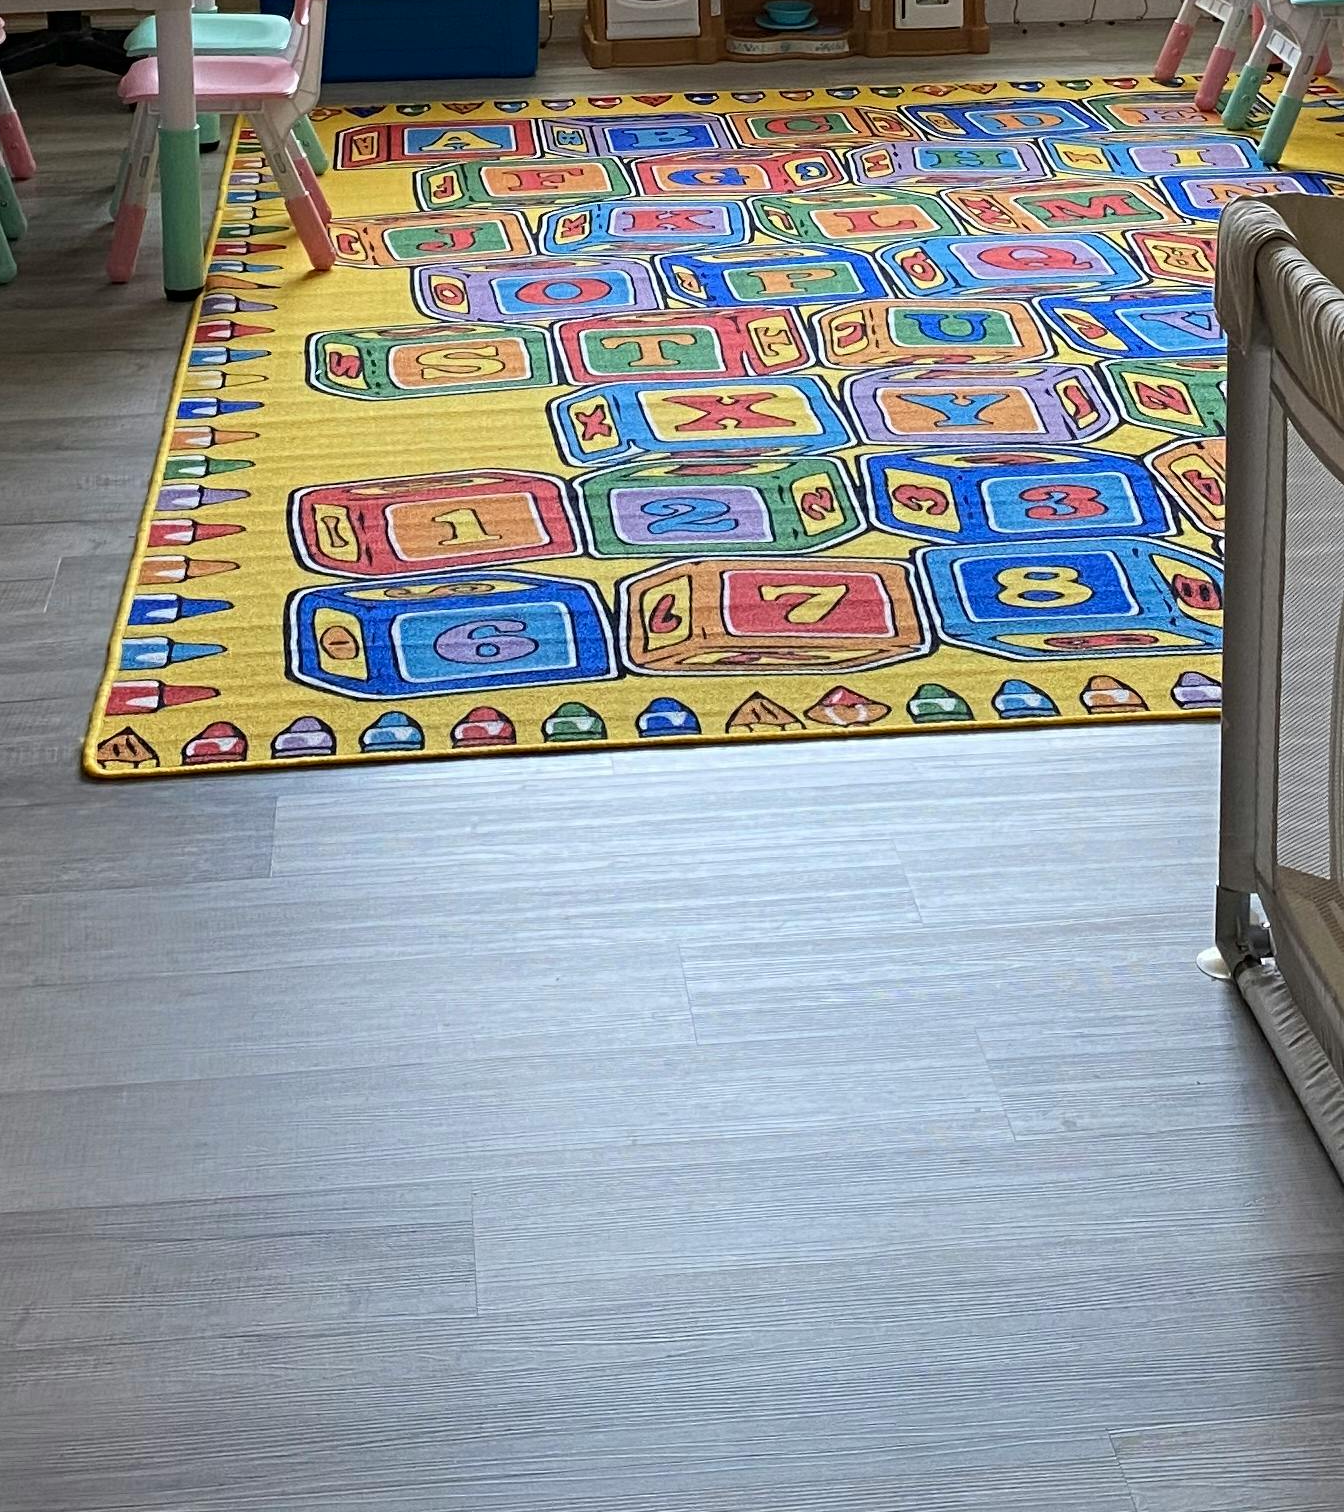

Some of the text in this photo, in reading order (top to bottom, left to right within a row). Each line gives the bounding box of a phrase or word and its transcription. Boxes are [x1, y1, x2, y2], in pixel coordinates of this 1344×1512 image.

[765, 116, 833, 134] C
[985, 112, 1064, 129] D
[1122, 105, 1209, 124] E
[419, 130, 503, 151] A
[622, 127, 696, 149] B
[924, 150, 1008, 169] H
[1163, 149, 1217, 168] I
[501, 167, 584, 192] F
[667, 167, 750, 186] G
[622, 209, 716, 232] K
[1032, 194, 1152, 222] M
[834, 211, 917, 233] L
[416, 226, 483, 252] J
[977, 245, 1093, 271] Q
[515, 278, 613, 305] O
[747, 268, 837, 294] P
[904, 313, 991, 342] U
[416, 345, 506, 381] S
[600, 333, 698, 367] T
[662, 392, 796, 432] X
[895, 393, 1010, 429] Y
[640, 497, 739, 534] 2
[1019, 485, 1108, 520] 3
[432, 507, 503, 546] 1
[993, 566, 1094, 608] 8
[758, 584, 850, 625] 7
[434, 619, 539, 664] 6
